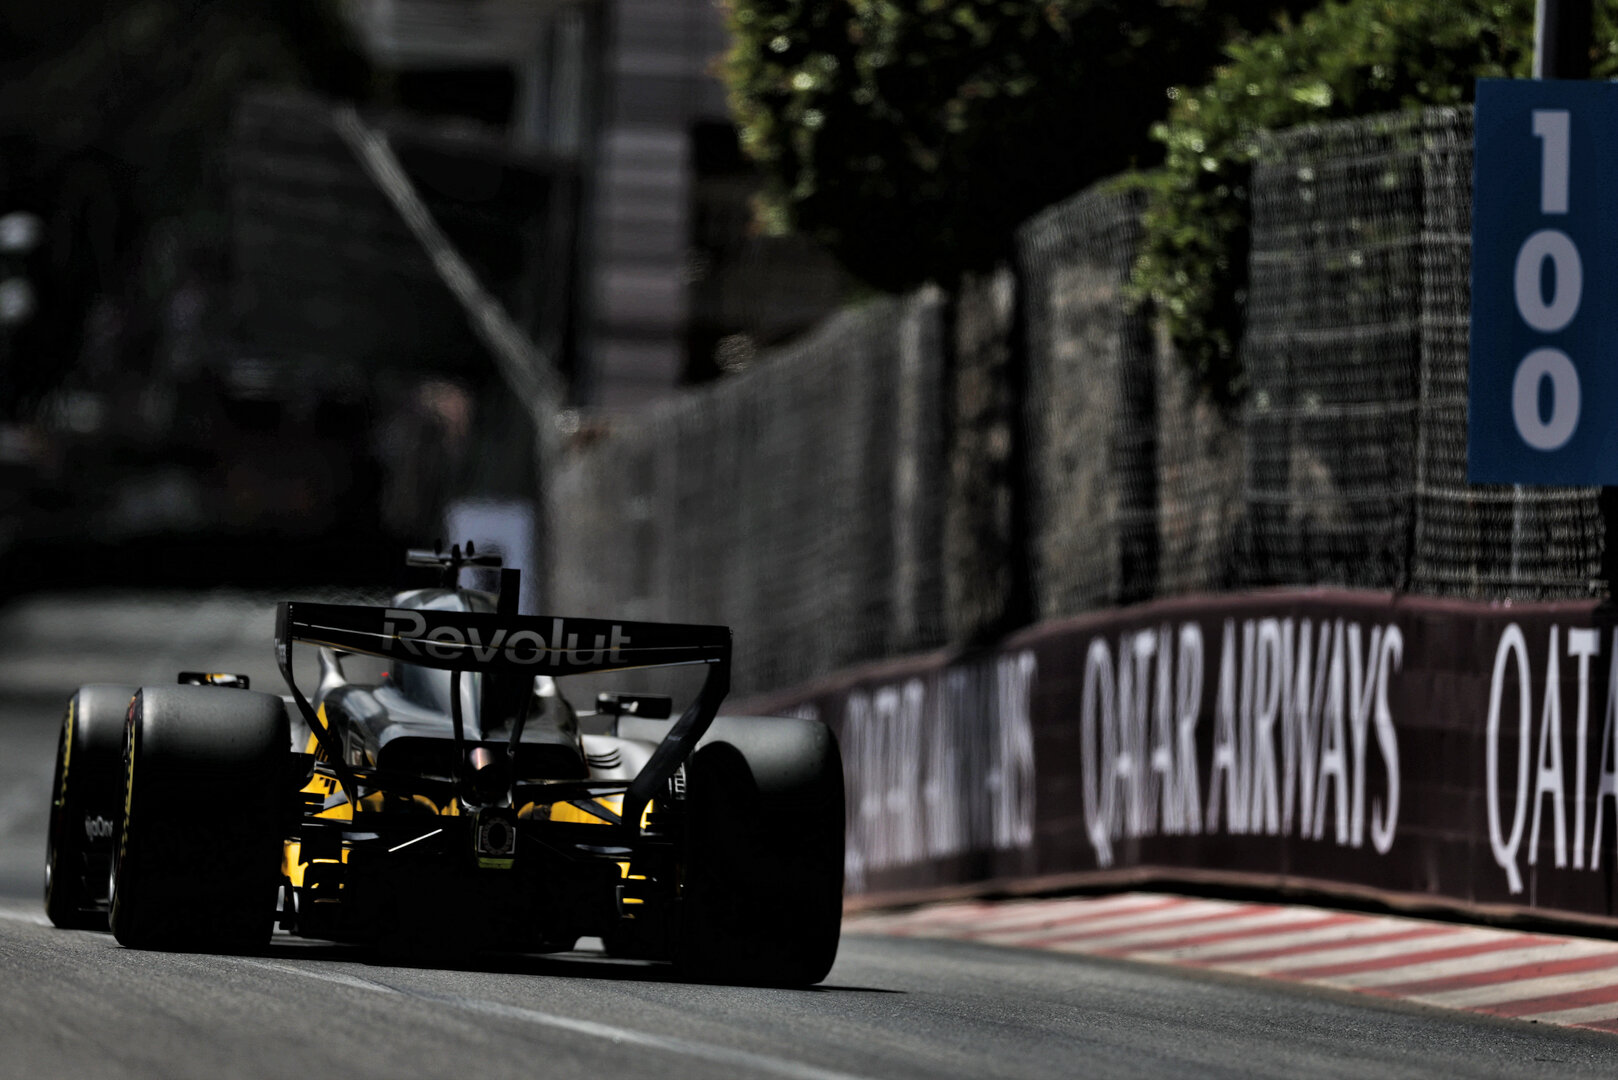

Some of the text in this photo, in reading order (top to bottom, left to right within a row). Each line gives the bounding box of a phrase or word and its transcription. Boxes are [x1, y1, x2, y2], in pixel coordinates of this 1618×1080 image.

[1511, 109, 1584, 453] 100
[381, 608, 632, 667] Revolut
[1080, 621, 1203, 868] QATAR
[1205, 616, 1404, 856] AIRWAYS
